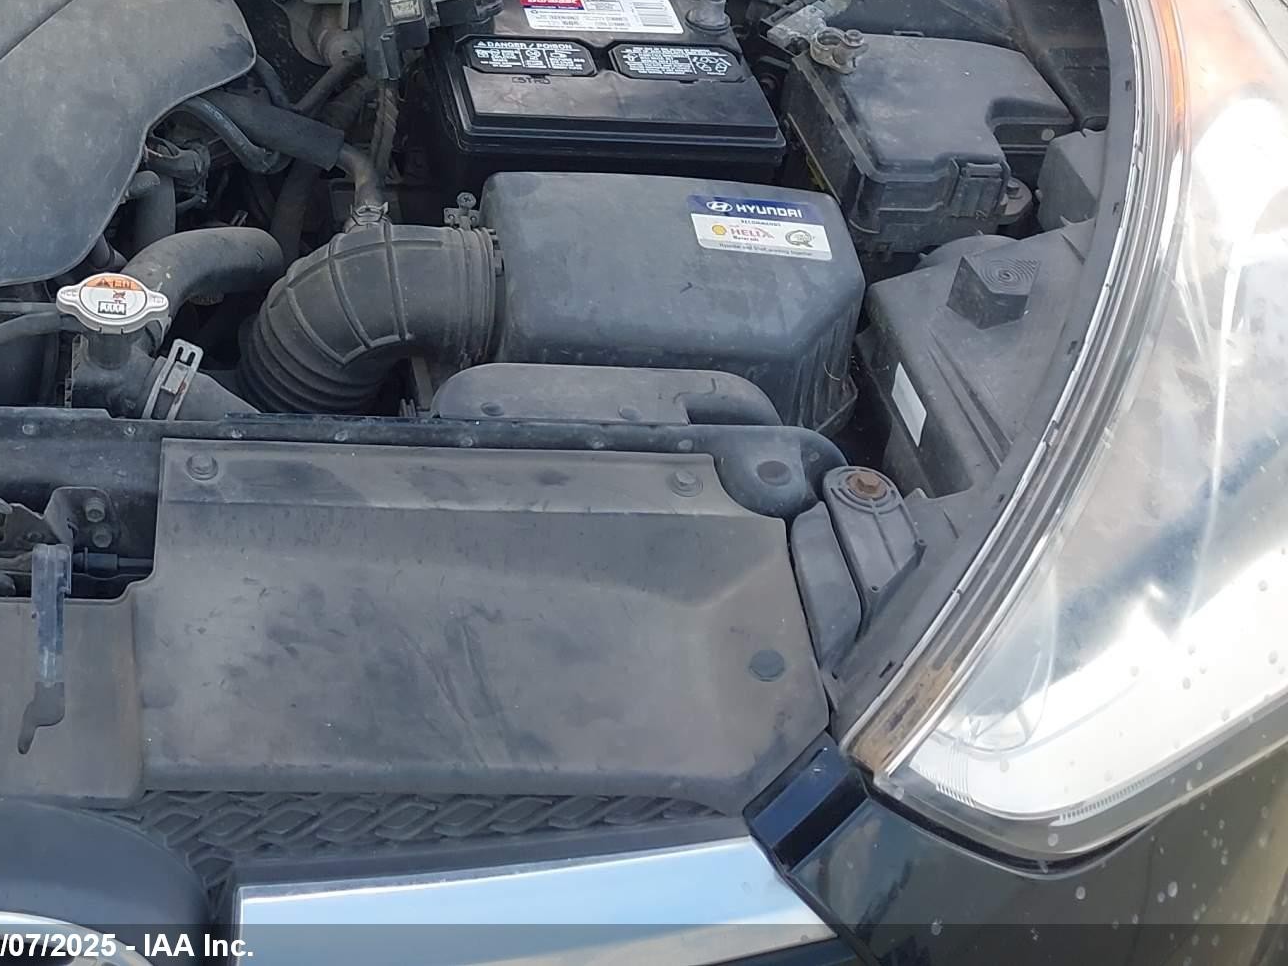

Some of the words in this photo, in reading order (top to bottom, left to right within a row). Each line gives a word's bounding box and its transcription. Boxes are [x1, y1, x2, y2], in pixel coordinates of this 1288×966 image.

[487, 40, 527, 49] DANGER
[536, 42, 572, 50] POISON
[736, 204, 803, 218] HYUNDAI
